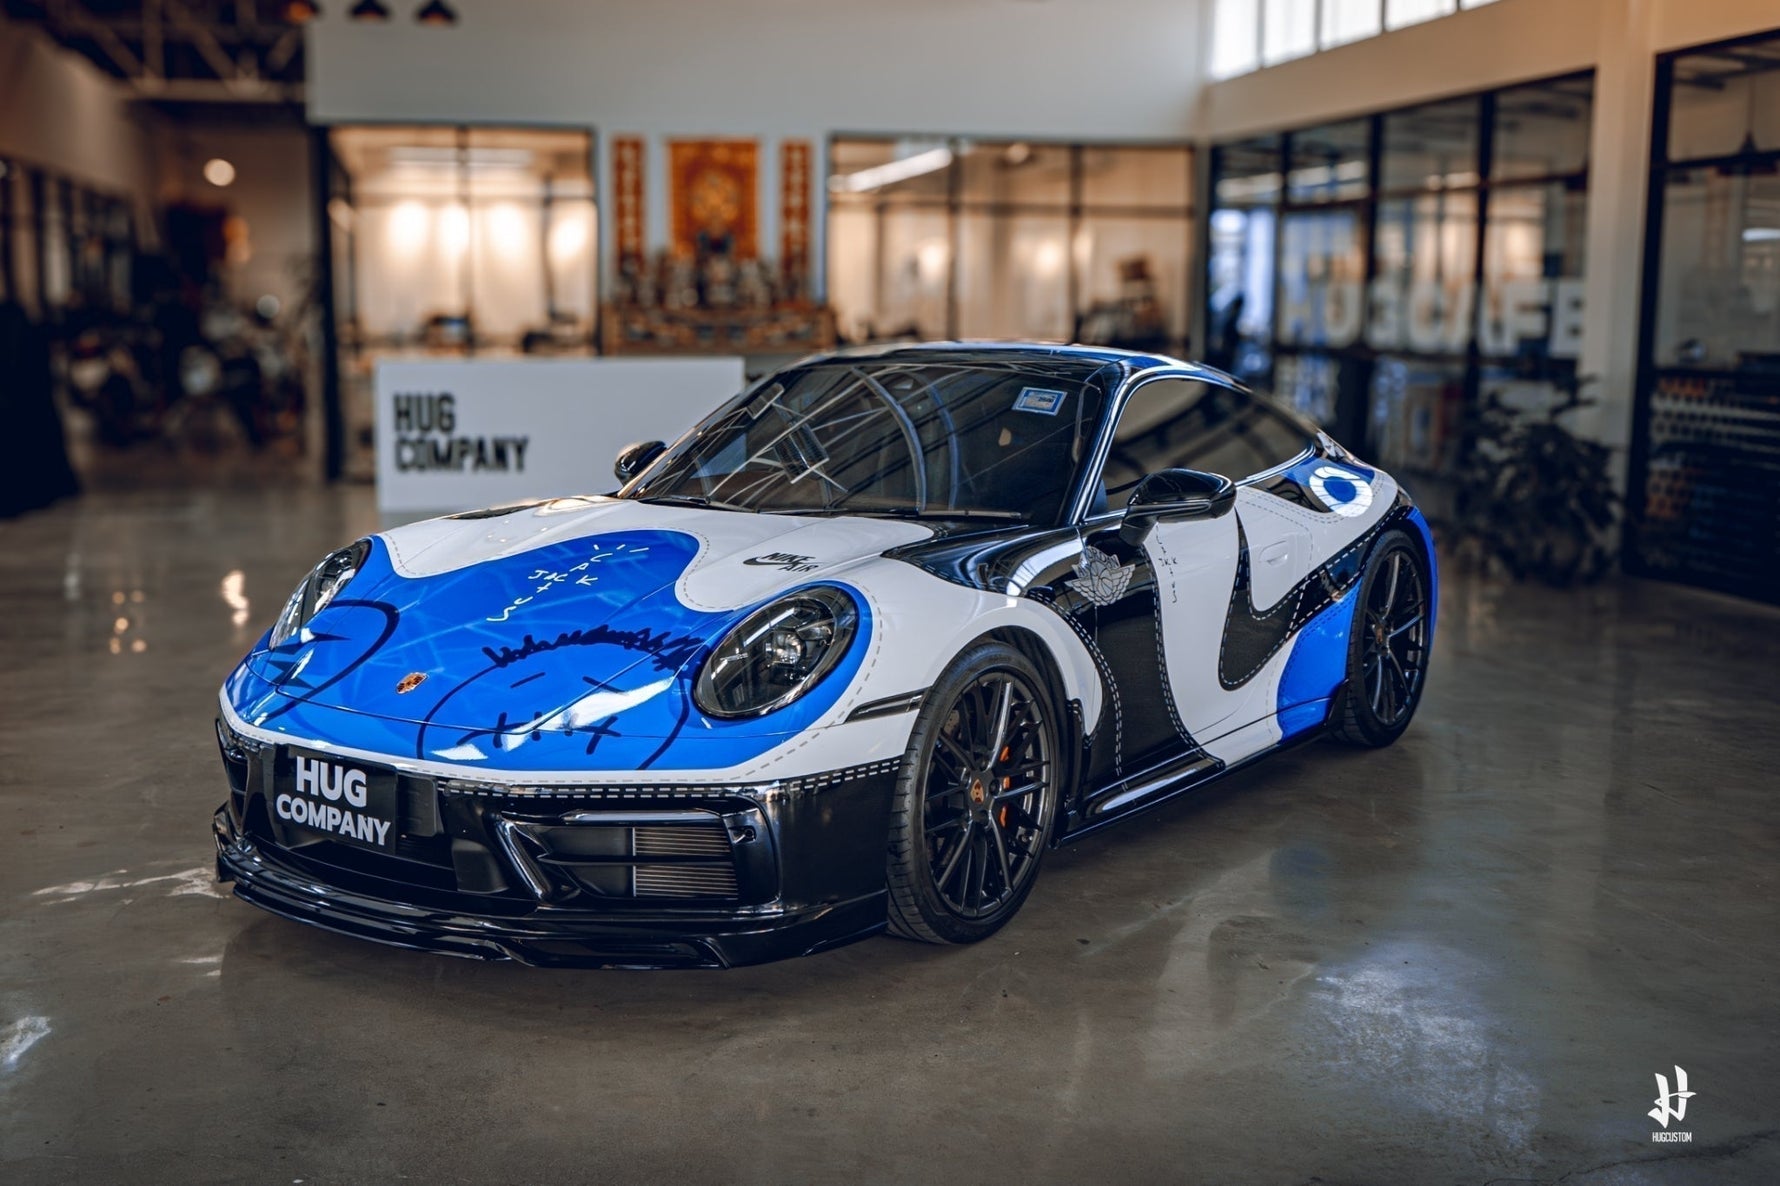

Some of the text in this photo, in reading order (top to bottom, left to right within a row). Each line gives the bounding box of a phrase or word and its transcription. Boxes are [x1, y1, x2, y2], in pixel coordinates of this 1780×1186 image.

[394, 392, 455, 432] HUG
[395, 436, 529, 472] COMPANY
[296, 756, 367, 808] HUG
[276, 793, 391, 846] COMPANY
